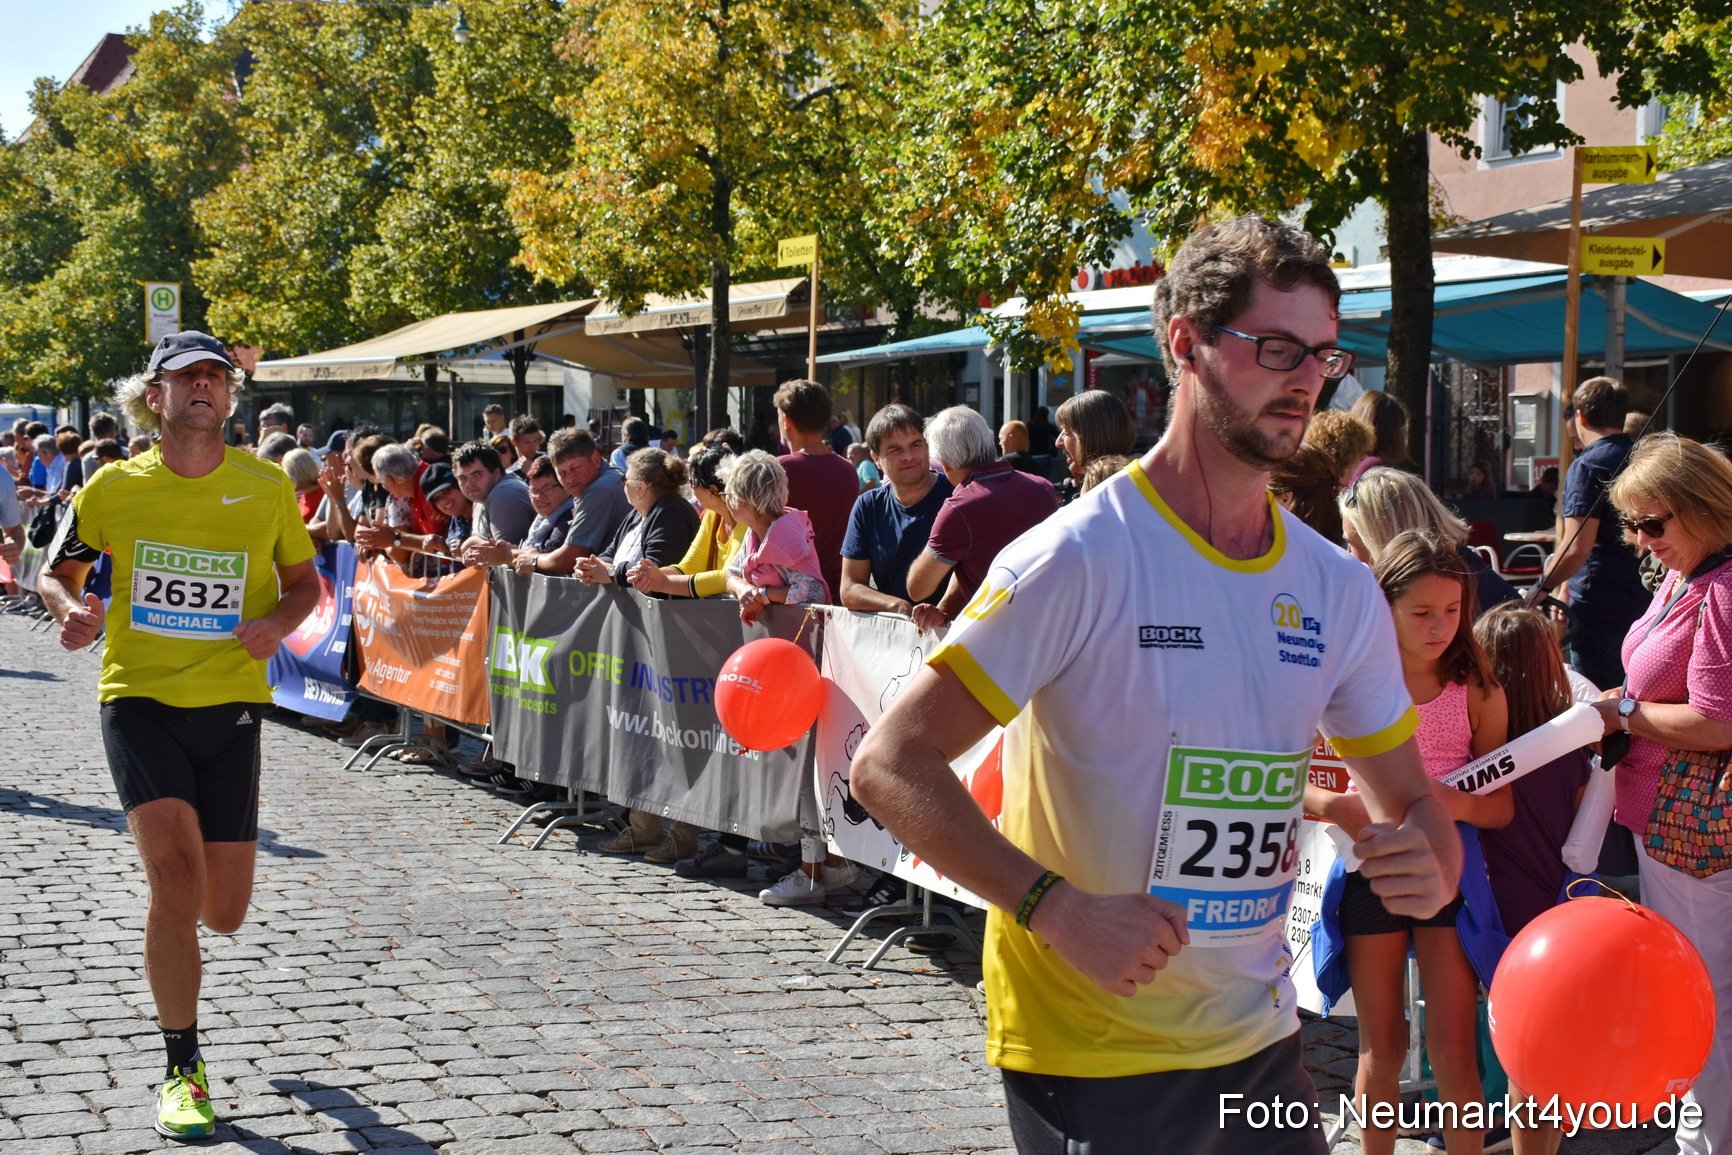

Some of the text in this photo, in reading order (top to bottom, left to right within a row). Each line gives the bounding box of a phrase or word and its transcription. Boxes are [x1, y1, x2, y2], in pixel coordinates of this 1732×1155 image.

[1592, 168, 1628, 181] ausgabe
[785, 244, 814, 258] Toiletten
[1588, 243, 1647, 256] Kleiderbeutel-
[1598, 258, 1635, 270] ausgabe
[158, 293, 169, 306] H
[142, 546, 236, 576] BOCK
[144, 576, 230, 609] 2632
[147, 611, 222, 630] MICHAEL
[1275, 602, 1301, 629] 20
[1139, 625, 1203, 643] BOCK
[236, 718, 253, 726] adidas
[1471, 748, 1509, 771] stadtwerke
[1443, 769, 1470, 785] neumar
[1179, 818, 1298, 879] 2358
[1304, 858, 1311, 874] 8
